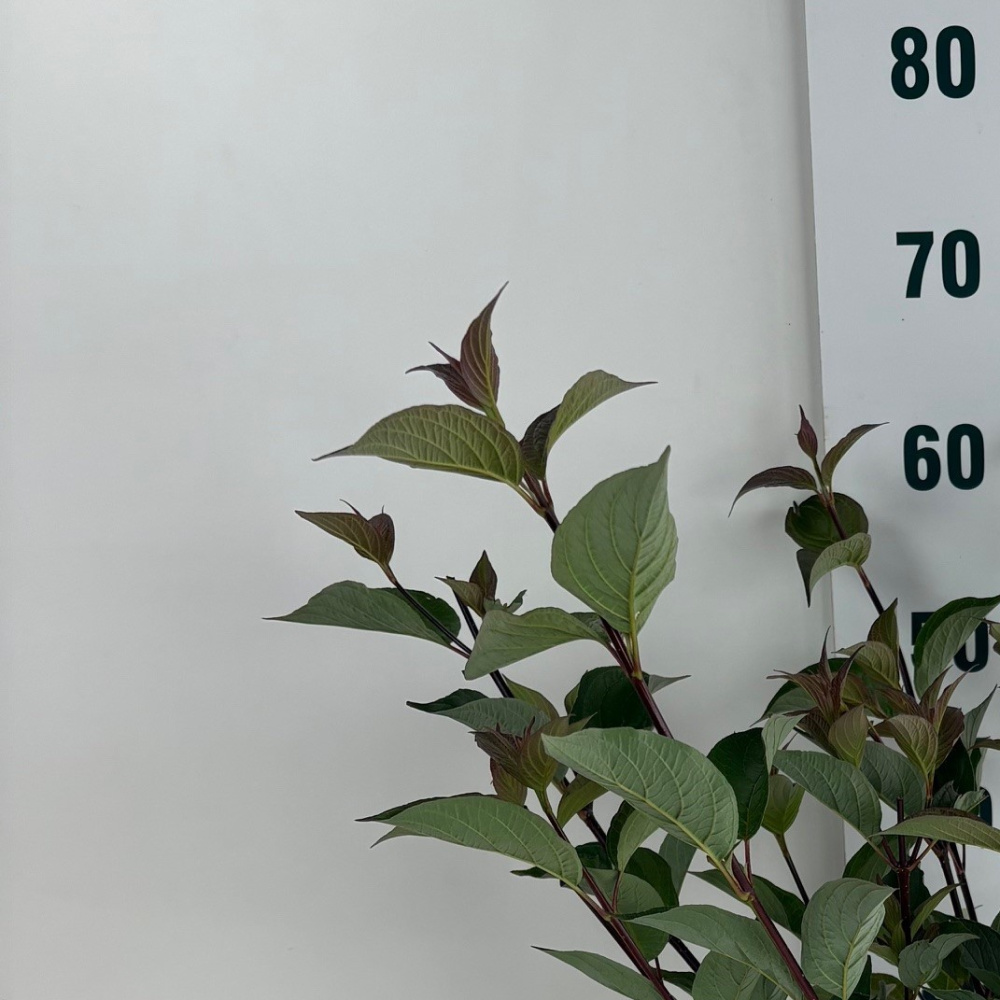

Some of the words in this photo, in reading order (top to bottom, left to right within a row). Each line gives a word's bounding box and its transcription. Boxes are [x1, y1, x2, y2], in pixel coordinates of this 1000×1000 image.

[891, 25, 976, 100] 80
[896, 229, 980, 298] 70
[903, 424, 985, 491] 60
